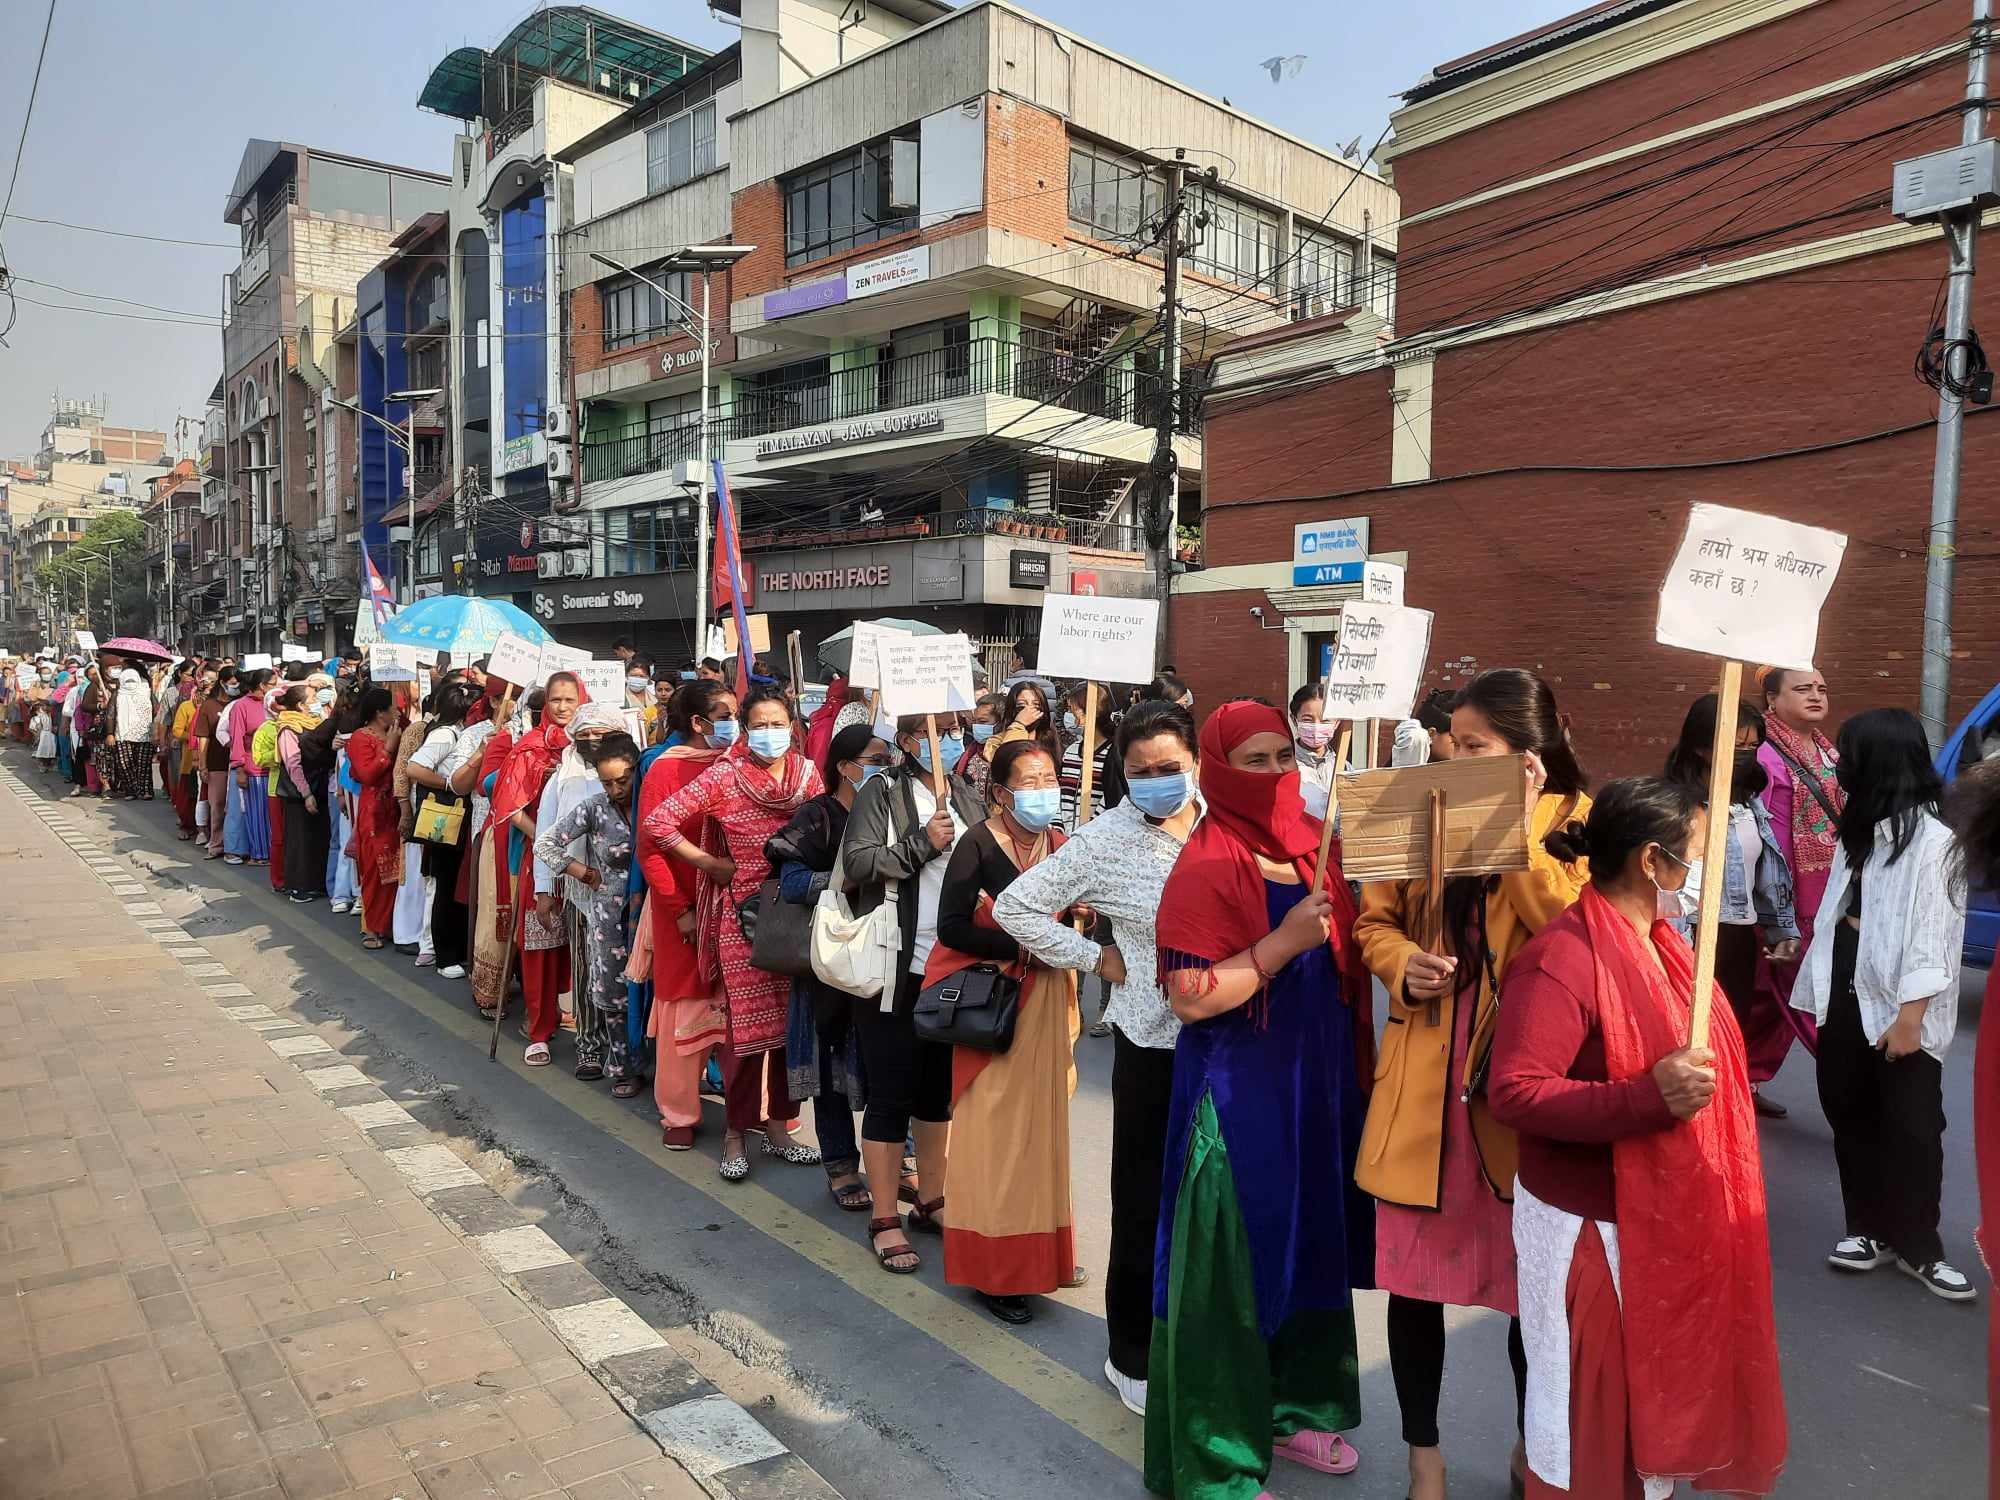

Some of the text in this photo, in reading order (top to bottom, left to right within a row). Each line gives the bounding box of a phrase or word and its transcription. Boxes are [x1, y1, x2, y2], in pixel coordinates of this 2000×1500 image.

[855, 278, 871, 290] ZEN
[756, 408, 939, 456] HIMALAYAN JAVA COFFEE
[1319, 528, 1358, 539] NMB BANK
[1019, 562, 1046, 574] BARISTA
[1698, 537, 1827, 581] हाम्रो श्रम अधिकार
[761, 572, 789, 592] THE
[792, 567, 844, 590] NORTH
[847, 565, 890, 587] FACE
[1315, 566, 1343, 582] ATM
[1688, 568, 1723, 590] कहाँ
[562, 592, 611, 610] Souvenir
[613, 590, 644, 609] Shop
[1062, 608, 1145, 626] Where are our
[1060, 624, 1132, 642] labor rights?
